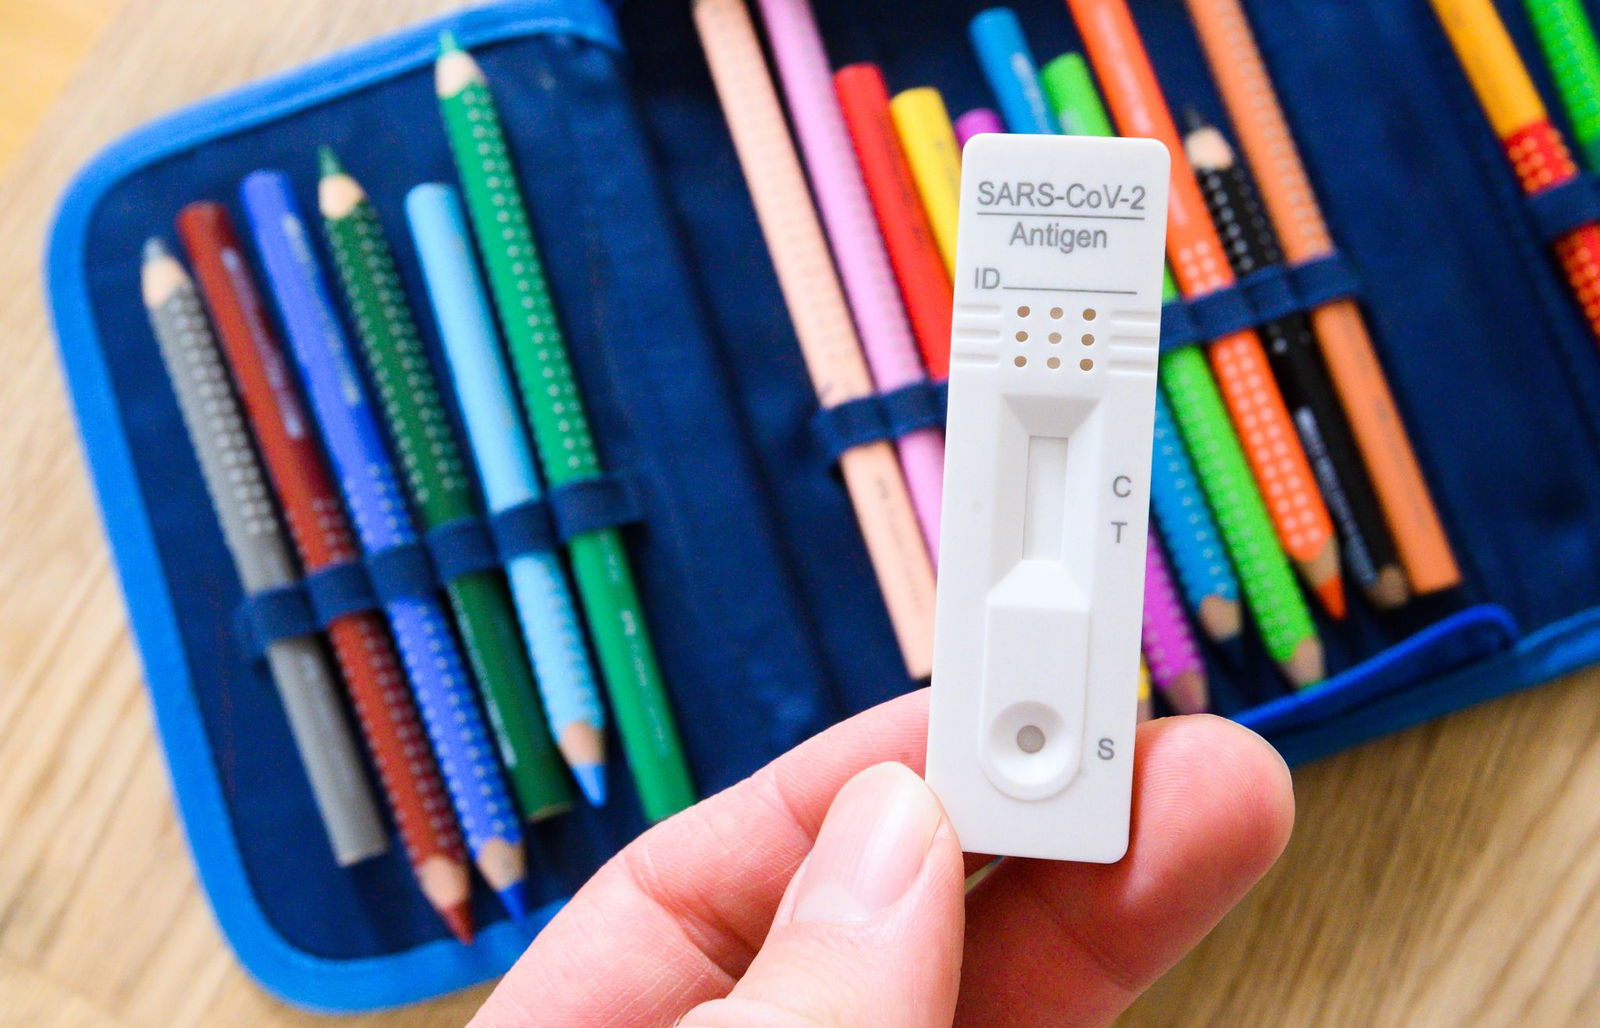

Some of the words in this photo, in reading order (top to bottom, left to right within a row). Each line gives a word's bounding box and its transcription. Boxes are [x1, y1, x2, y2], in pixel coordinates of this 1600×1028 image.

[977, 180, 1146, 211] SARS-CoV-2
[1009, 221, 1108, 255] Antigen
[974, 267, 1001, 290] ID
[1112, 475, 1132, 499] C
[1110, 521, 1128, 544] T
[1097, 737, 1115, 761] S
